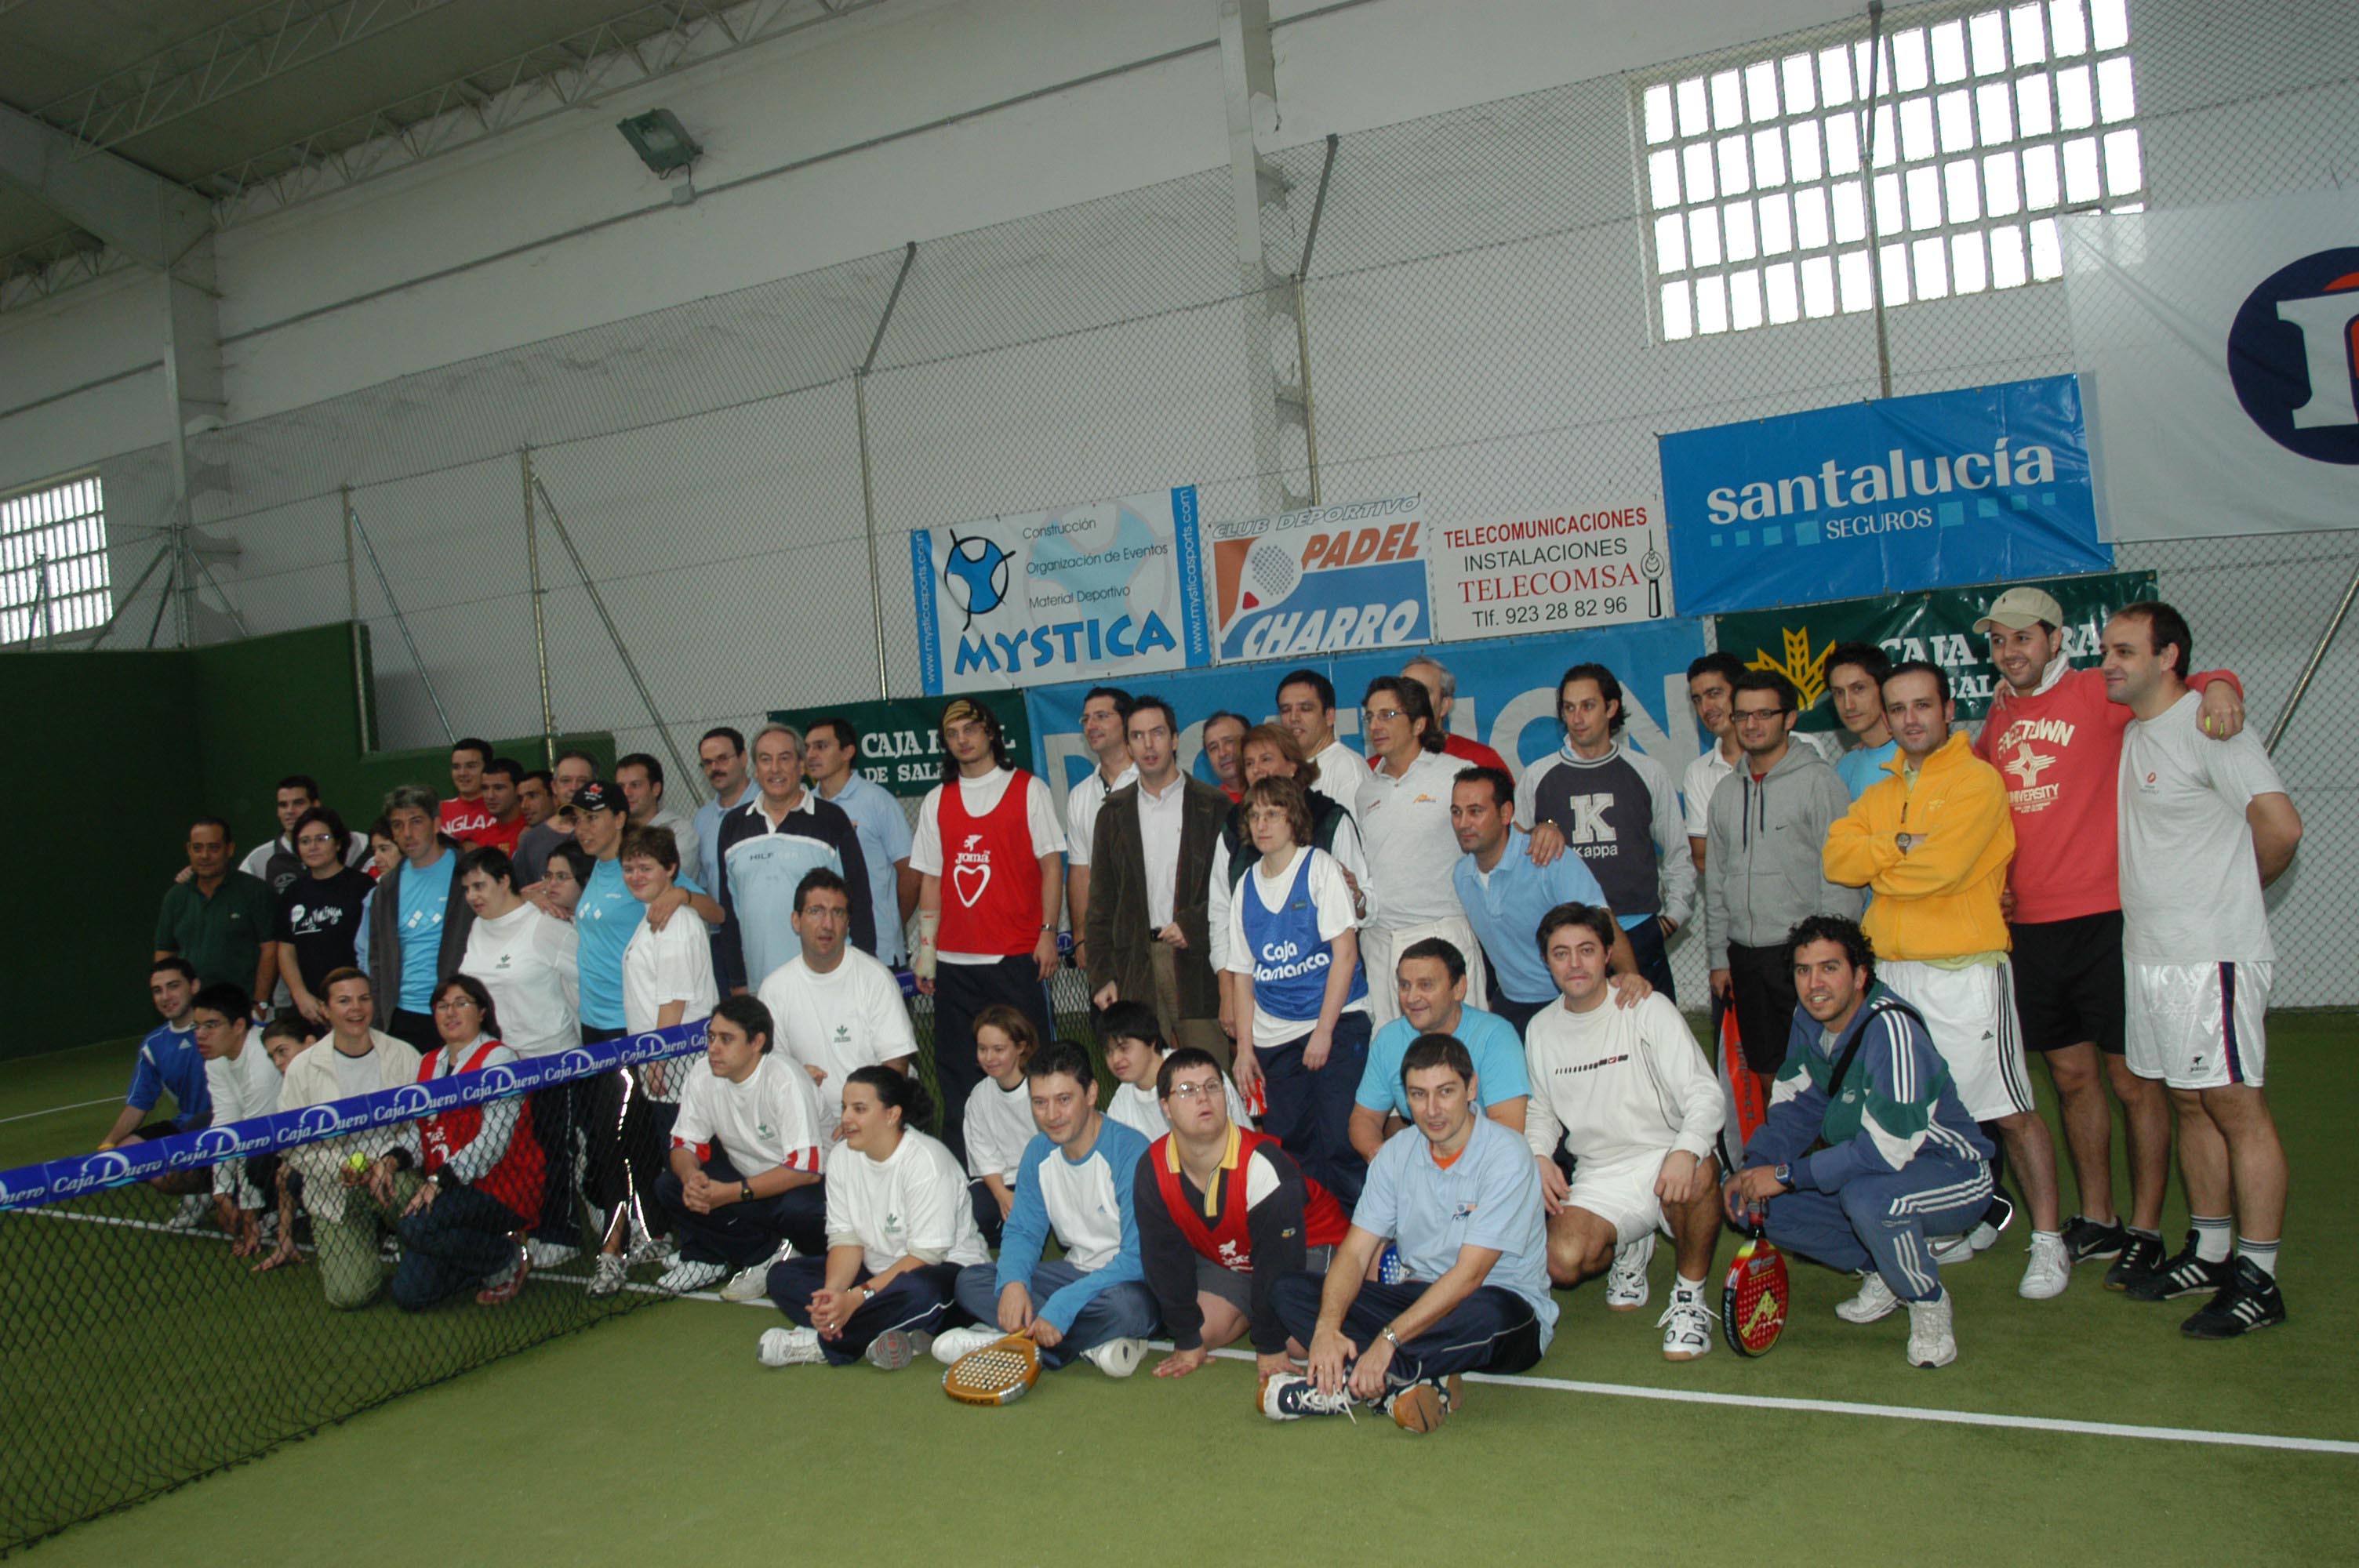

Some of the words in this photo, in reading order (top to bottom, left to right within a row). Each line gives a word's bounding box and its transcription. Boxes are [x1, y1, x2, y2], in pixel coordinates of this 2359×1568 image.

[1707, 437, 2055, 525] santalucía
[1023, 517, 1096, 540] Construcción
[1212, 518, 1269, 539] CLUB
[1276, 495, 1421, 532] DEPORTIVO
[1444, 506, 1648, 550] TELECOMUNICACIONES
[1826, 508, 1932, 539] SEGUROS
[1027, 553, 1102, 575] Organización
[1105, 550, 1120, 563] de
[1122, 543, 1168, 561] Eventos
[1301, 521, 1421, 570] PADEL
[1464, 538, 1627, 572] INSTALACIONES
[1180, 489, 1202, 655] www.mysticasports.com
[1458, 562, 1640, 604] TELECOMSA
[1029, 593, 1074, 609] Material
[1077, 585, 1131, 603] Deportivo
[1505, 605, 1539, 624] 923
[1546, 603, 1568, 620] 28
[1574, 600, 1598, 618] 82
[1604, 596, 1627, 615] 96
[954, 610, 1176, 676] MYSTICA
[1242, 599, 1419, 655] CHARRO
[1879, 633, 1978, 667] CAJA
[861, 730, 923, 759] CAJA
[1997, 717, 2075, 760] FREETOWN
[865, 767, 889, 784] DE
[1570, 793, 1617, 844] K
[1262, 940, 1298, 963] Caja
[544, 1065, 572, 1081] Caja
[561, 1049, 617, 1074] Duero
[620, 1050, 646, 1064] Caja
[636, 1033, 687, 1057] Duero
[463, 1086, 493, 1102] Caja
[481, 1065, 540, 1094] Duero
[373, 1105, 405, 1122] Caja
[394, 1085, 457, 1114] Duero
[277, 1126, 311, 1144] Caja
[300, 1105, 368, 1136] Duero
[170, 1148, 208, 1166] Caja
[196, 1127, 271, 1156] Duero
[53, 1174, 95, 1194] Caja
[81, 1151, 163, 1185] Duero
